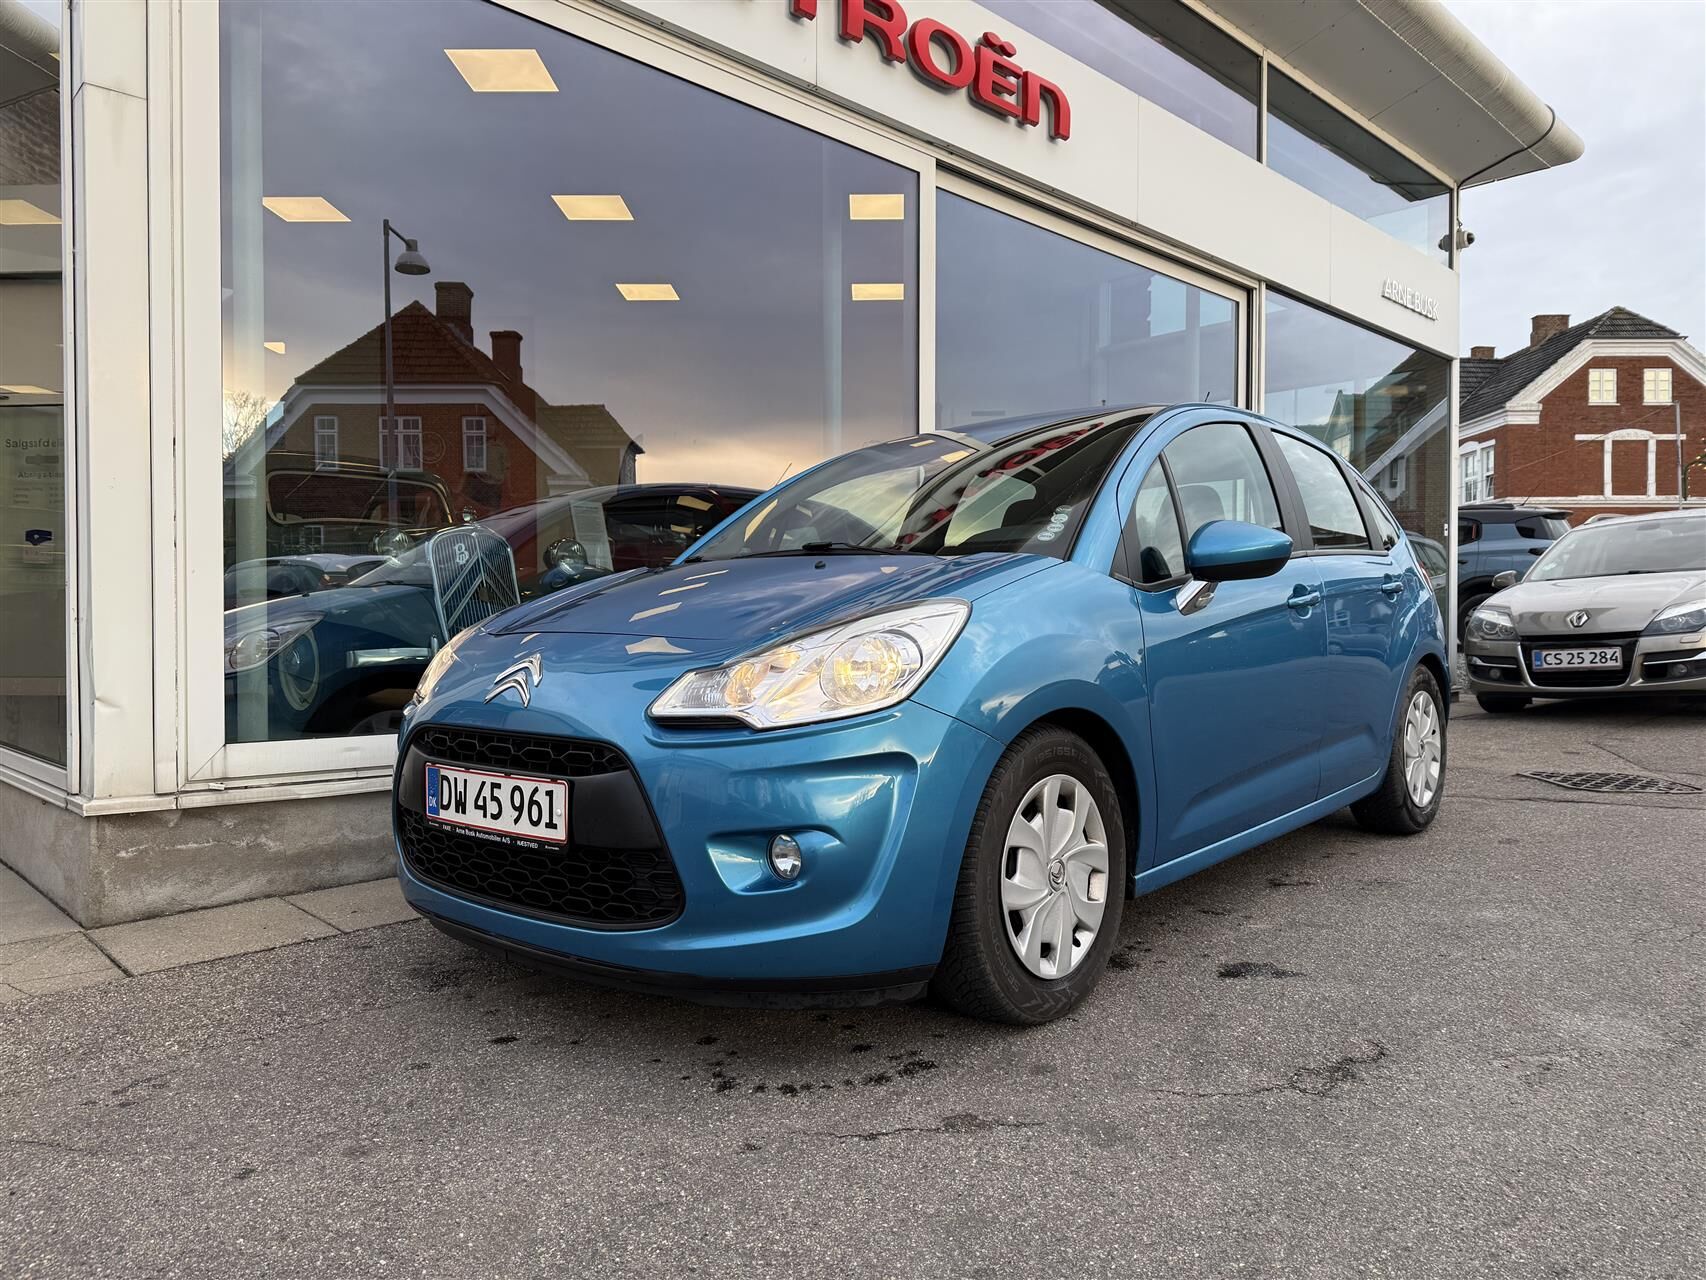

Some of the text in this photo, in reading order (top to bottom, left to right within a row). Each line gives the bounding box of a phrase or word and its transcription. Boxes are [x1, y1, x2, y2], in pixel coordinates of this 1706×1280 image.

[1384, 277, 1439, 320] ARNE BUSK
[1543, 652, 1563, 666] CS
[1567, 652, 1585, 665] 25
[1589, 650, 1619, 665] 284
[429, 795, 437, 808] DK
[440, 774, 558, 830] DW 45 961
